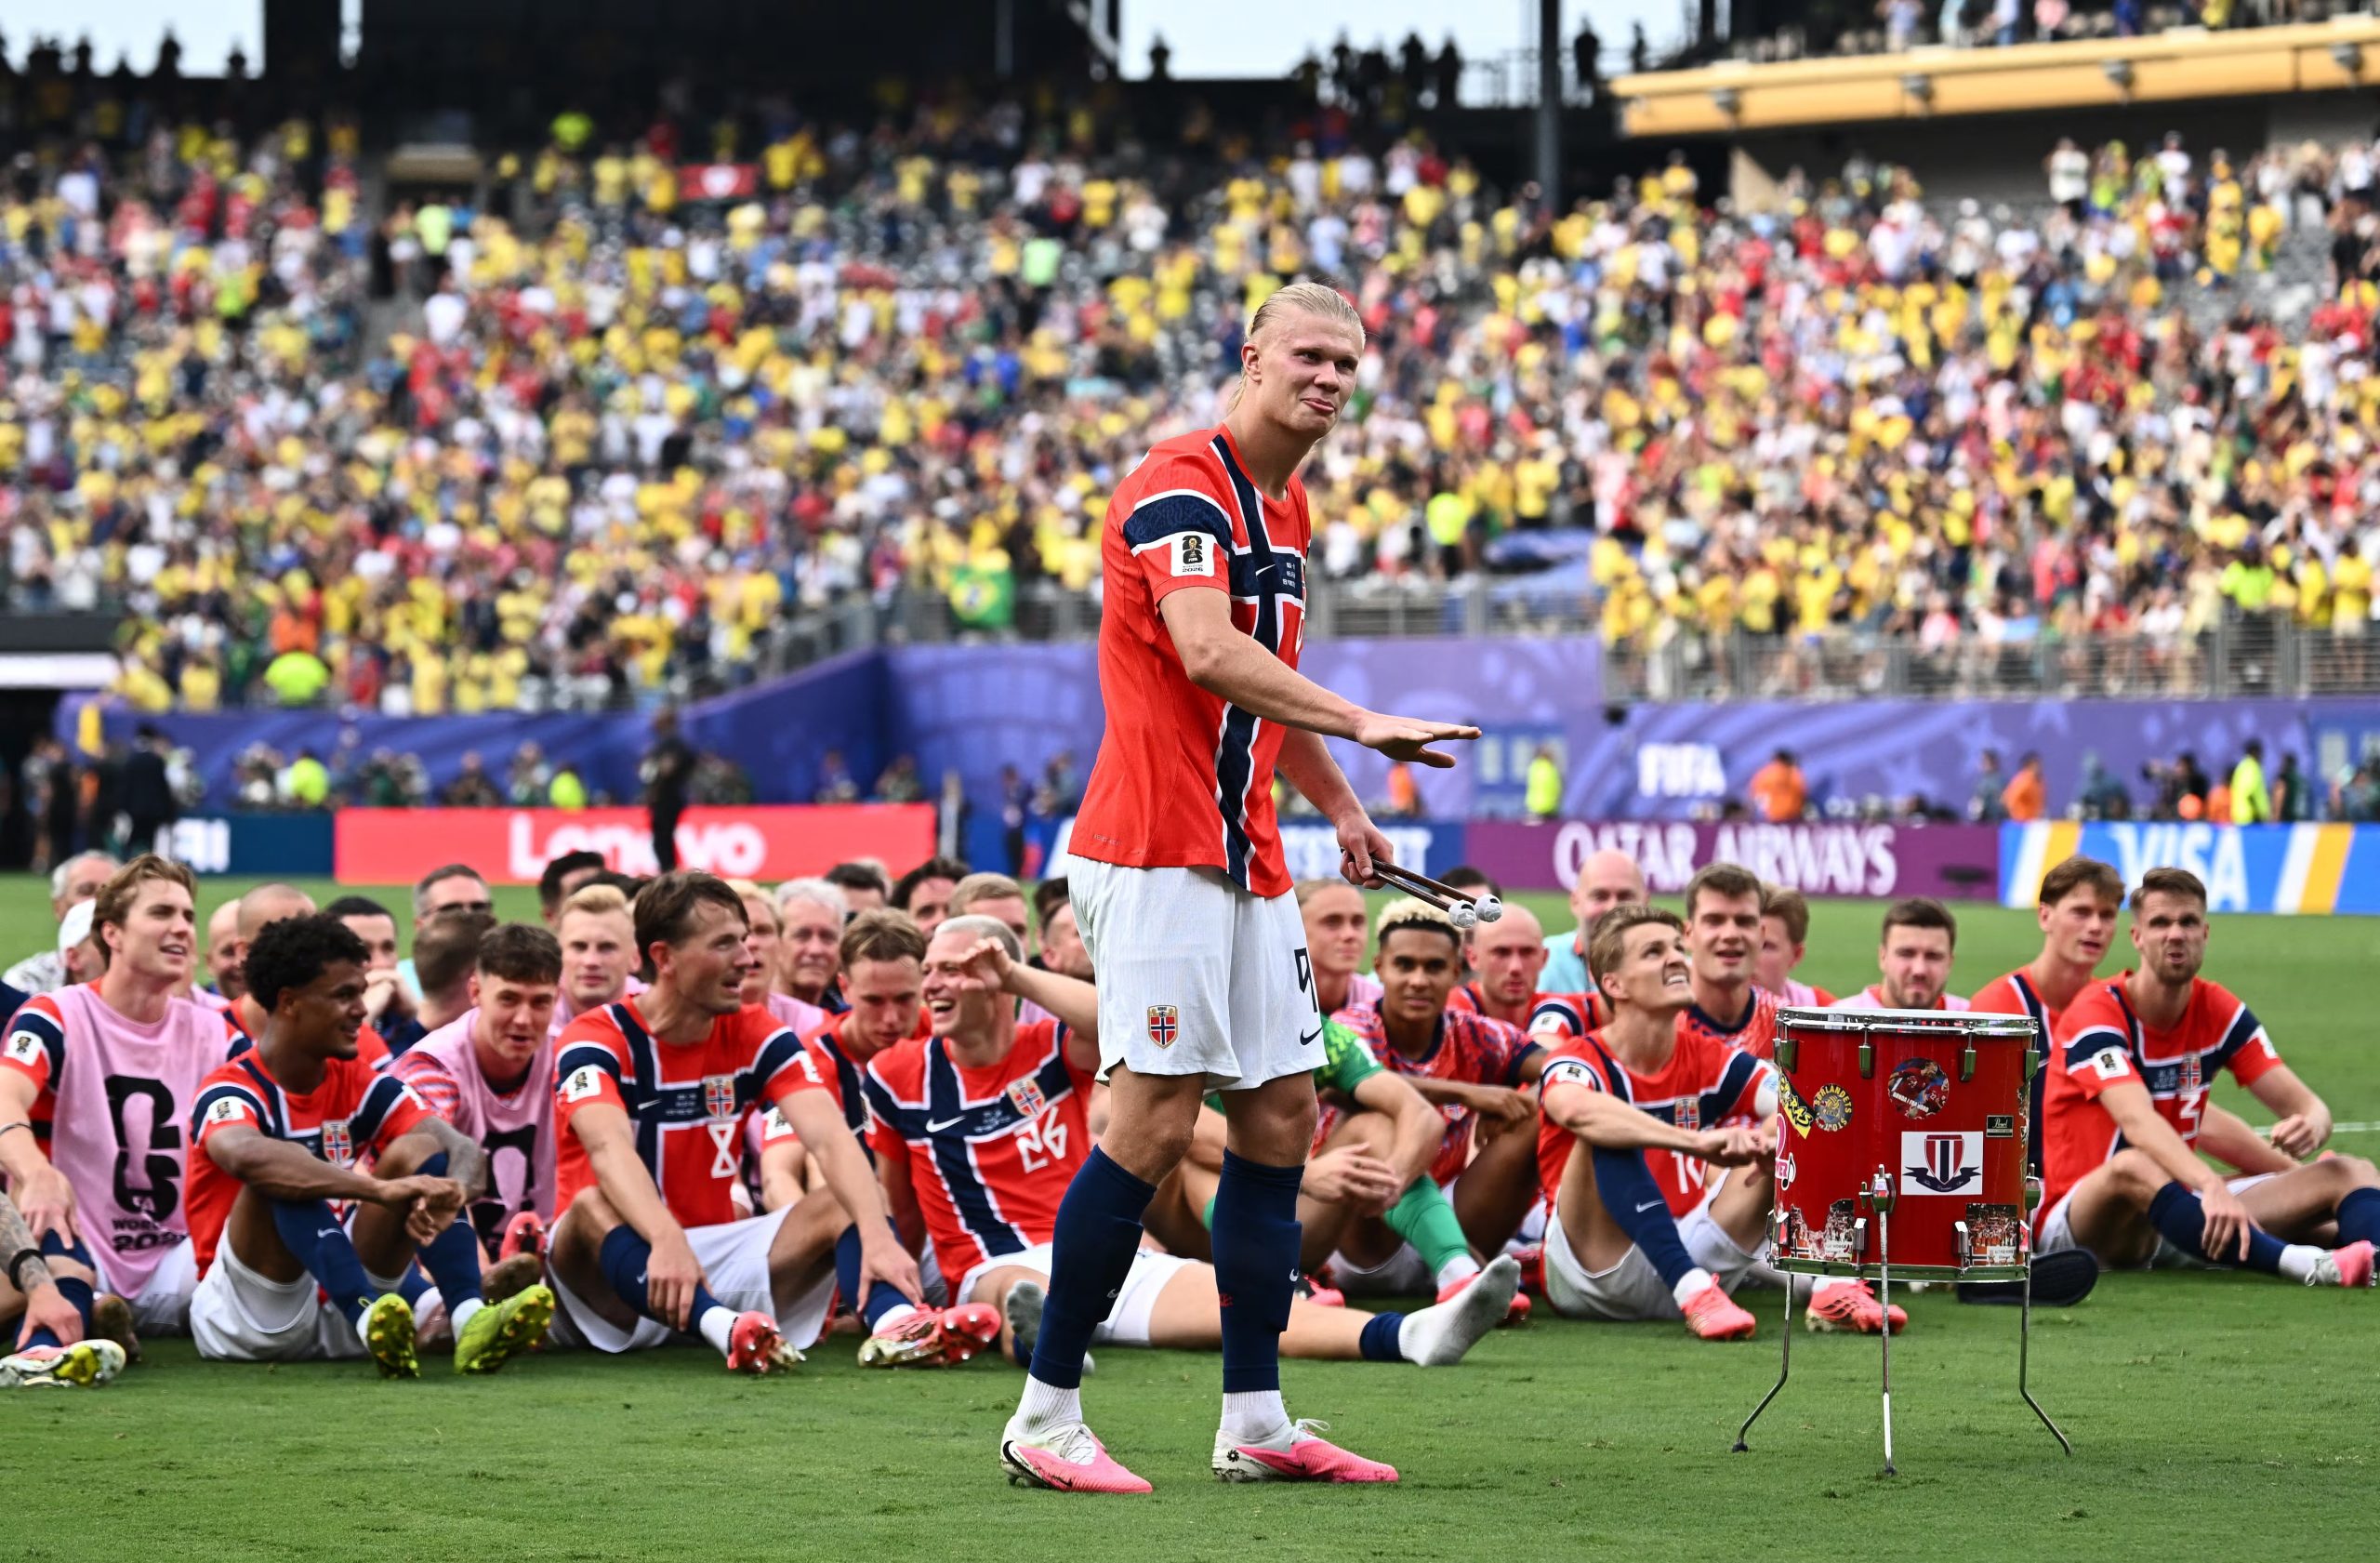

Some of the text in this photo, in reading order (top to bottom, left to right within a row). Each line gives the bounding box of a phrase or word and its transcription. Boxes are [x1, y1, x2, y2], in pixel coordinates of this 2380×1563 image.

[1638, 742, 1726, 798] FIFA
[1712, 824, 1897, 896] AIRWAYS
[2110, 823, 2247, 910] VISA
[1294, 947, 1318, 1013] 9
[1013, 1106, 1067, 1174] 26
[2179, 1093, 2202, 1142] 3
[707, 1123, 739, 1179] 8
